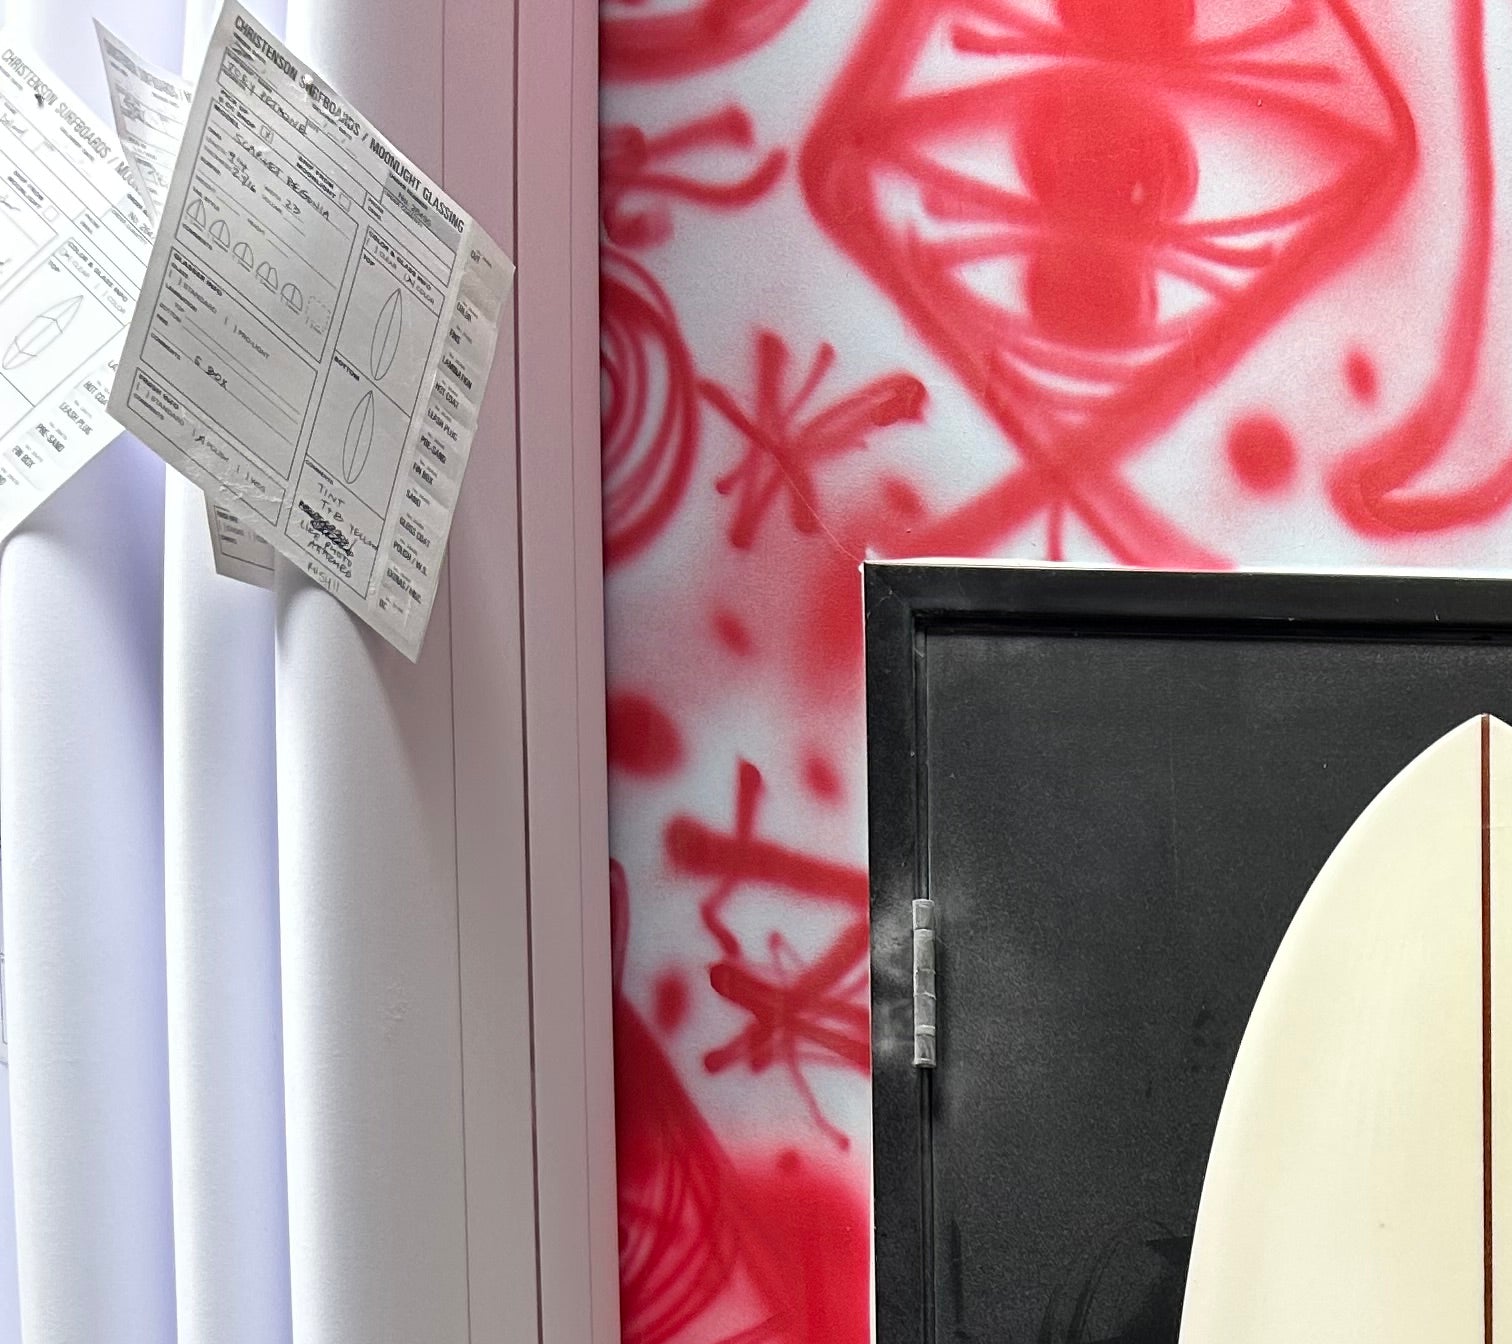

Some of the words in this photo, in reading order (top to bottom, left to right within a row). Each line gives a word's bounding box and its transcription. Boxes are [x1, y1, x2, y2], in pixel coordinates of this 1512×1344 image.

[234, 14, 297, 82] CHRISTENSON
[369, 136, 421, 194] MOONLIGHT
[421, 185, 465, 234] GLASSING
[316, 480, 345, 512] TINT
